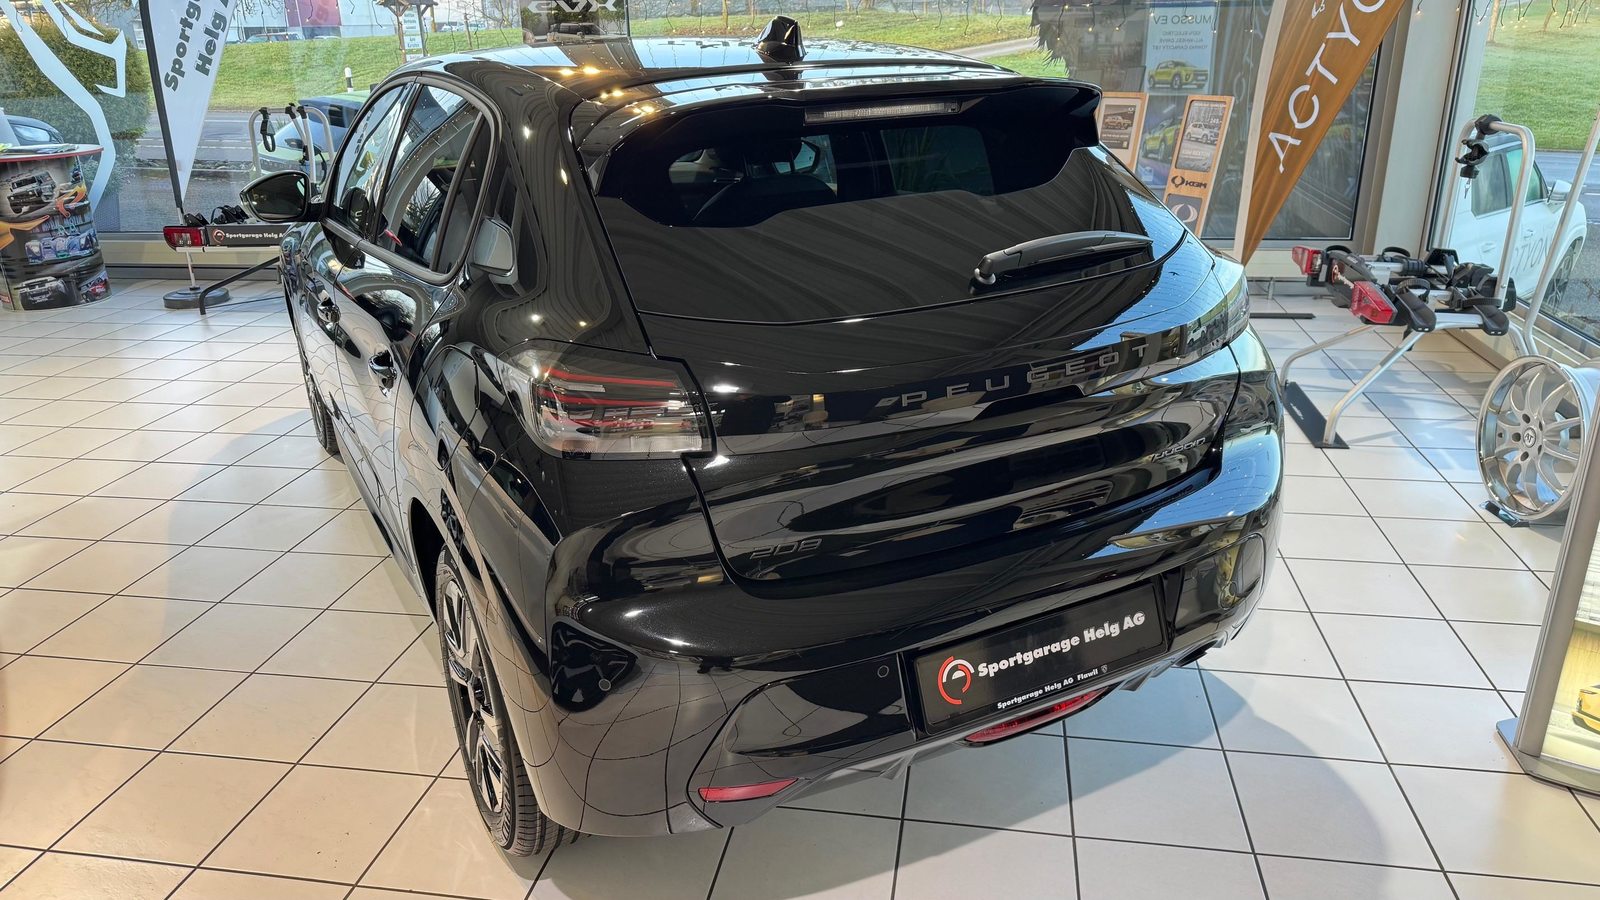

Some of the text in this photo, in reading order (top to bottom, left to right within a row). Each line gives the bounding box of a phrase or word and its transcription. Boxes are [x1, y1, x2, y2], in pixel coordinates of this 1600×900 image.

[164, 0, 201, 91] Sportg
[194, 10, 228, 77] Helg
[1185, 180, 1207, 189] KGM
[901, 343, 1151, 408] PEUGEOT
[750, 538, 823, 559] 208
[978, 611, 1146, 677] Sportgarage Helg AG
[997, 669, 1098, 709] Sportgarage Helg AG Flawil
